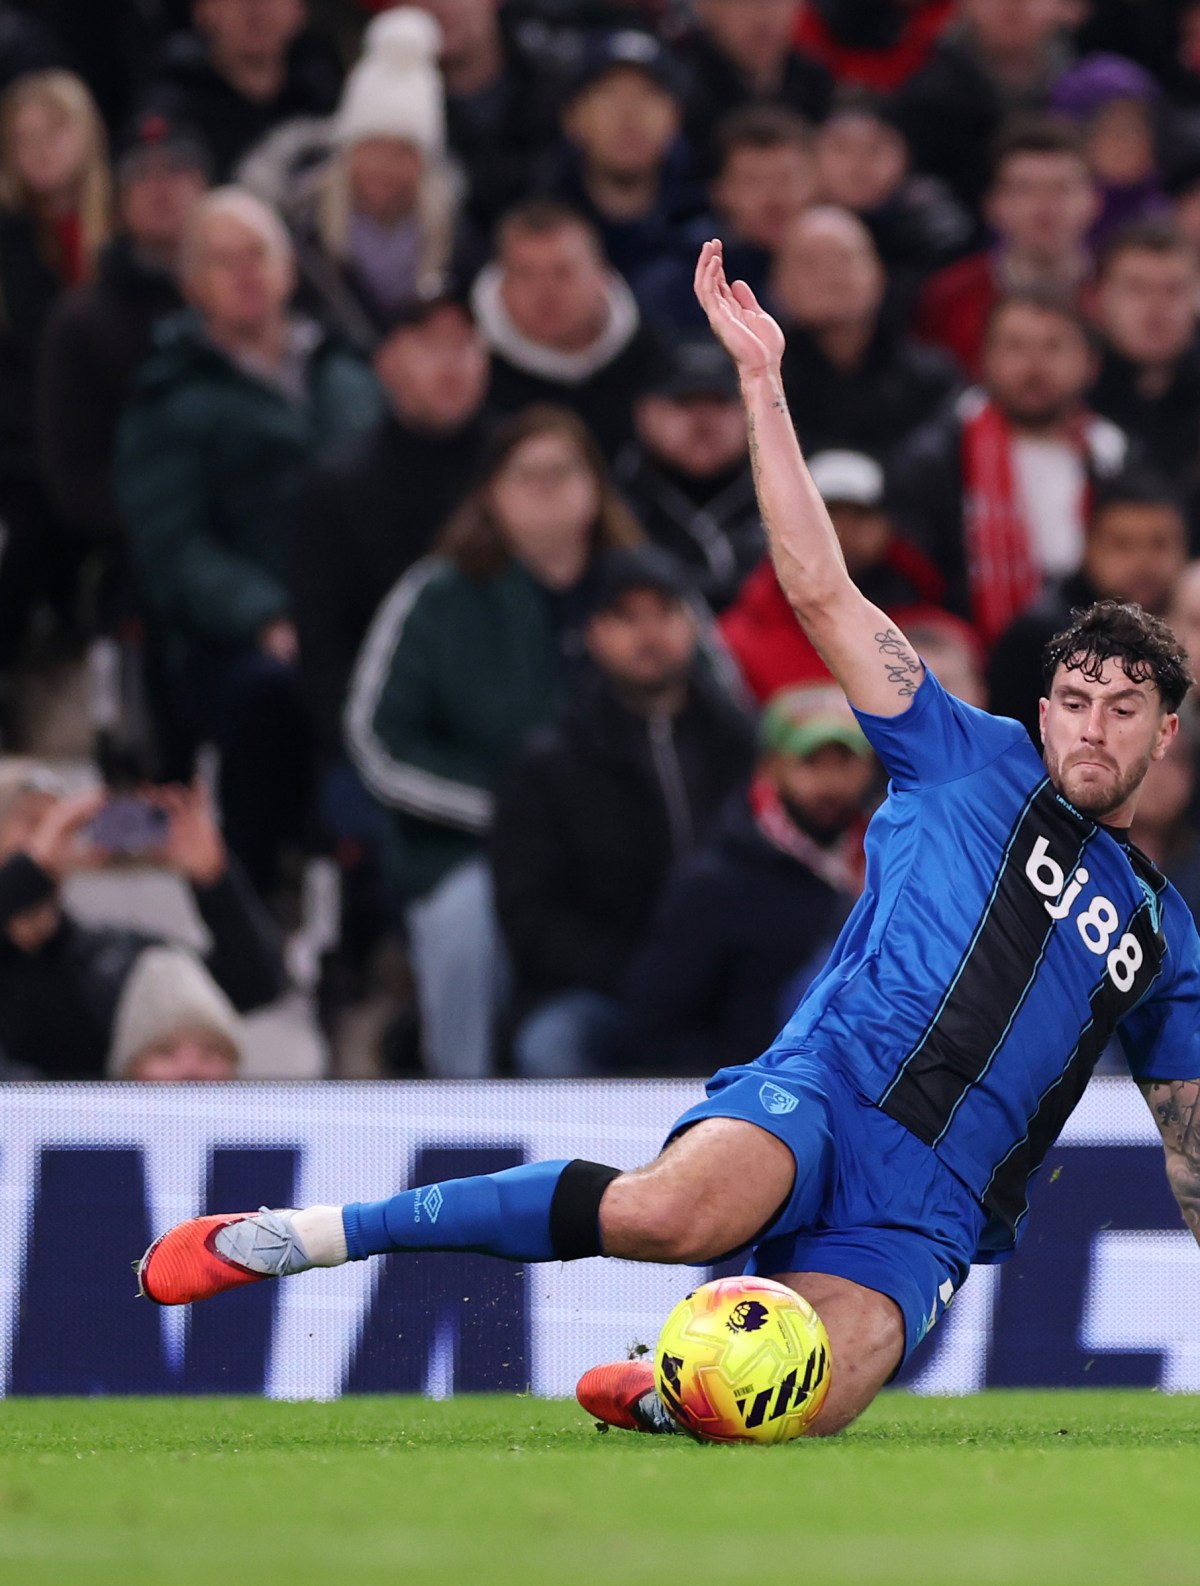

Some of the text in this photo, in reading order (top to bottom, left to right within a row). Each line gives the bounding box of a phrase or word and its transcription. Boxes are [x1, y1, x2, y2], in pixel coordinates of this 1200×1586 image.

[1055, 794, 1084, 821] umbro
[1025, 834, 1144, 993] bj88
[413, 1188, 423, 1223] umbro
